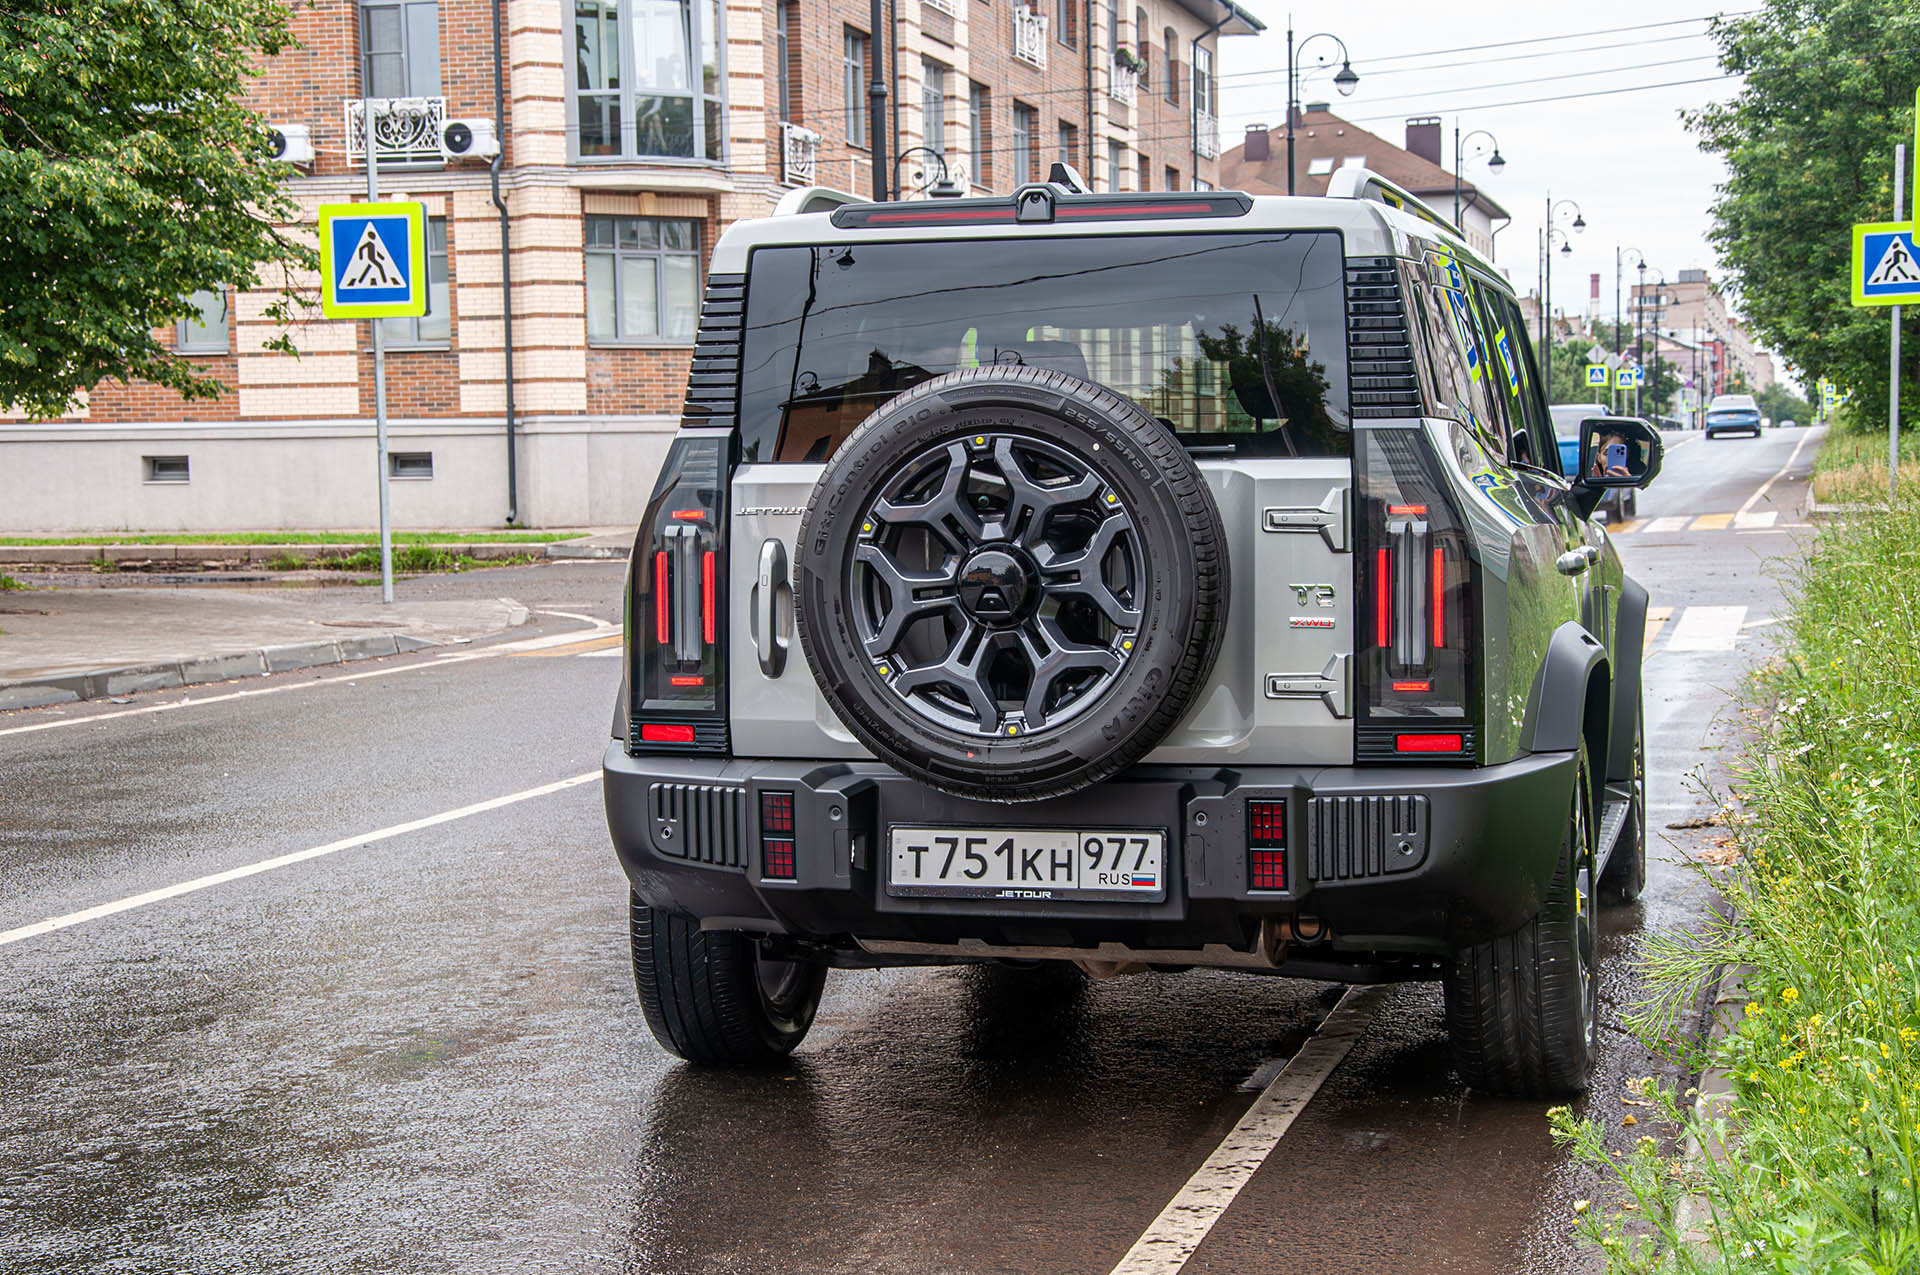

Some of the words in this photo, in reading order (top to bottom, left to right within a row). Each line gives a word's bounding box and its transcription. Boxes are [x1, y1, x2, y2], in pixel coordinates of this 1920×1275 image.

[1064, 407, 1152, 481] 255/55R20
[814, 434, 889, 556] GitiControl
[735, 507, 808, 516] JETOUR
[1289, 583, 1335, 608] T2
[1293, 619, 1332, 627] XWD
[1083, 837, 1150, 871] 977
[1098, 873, 1130, 885] RUS
[995, 889, 1051, 899] JETOUR
